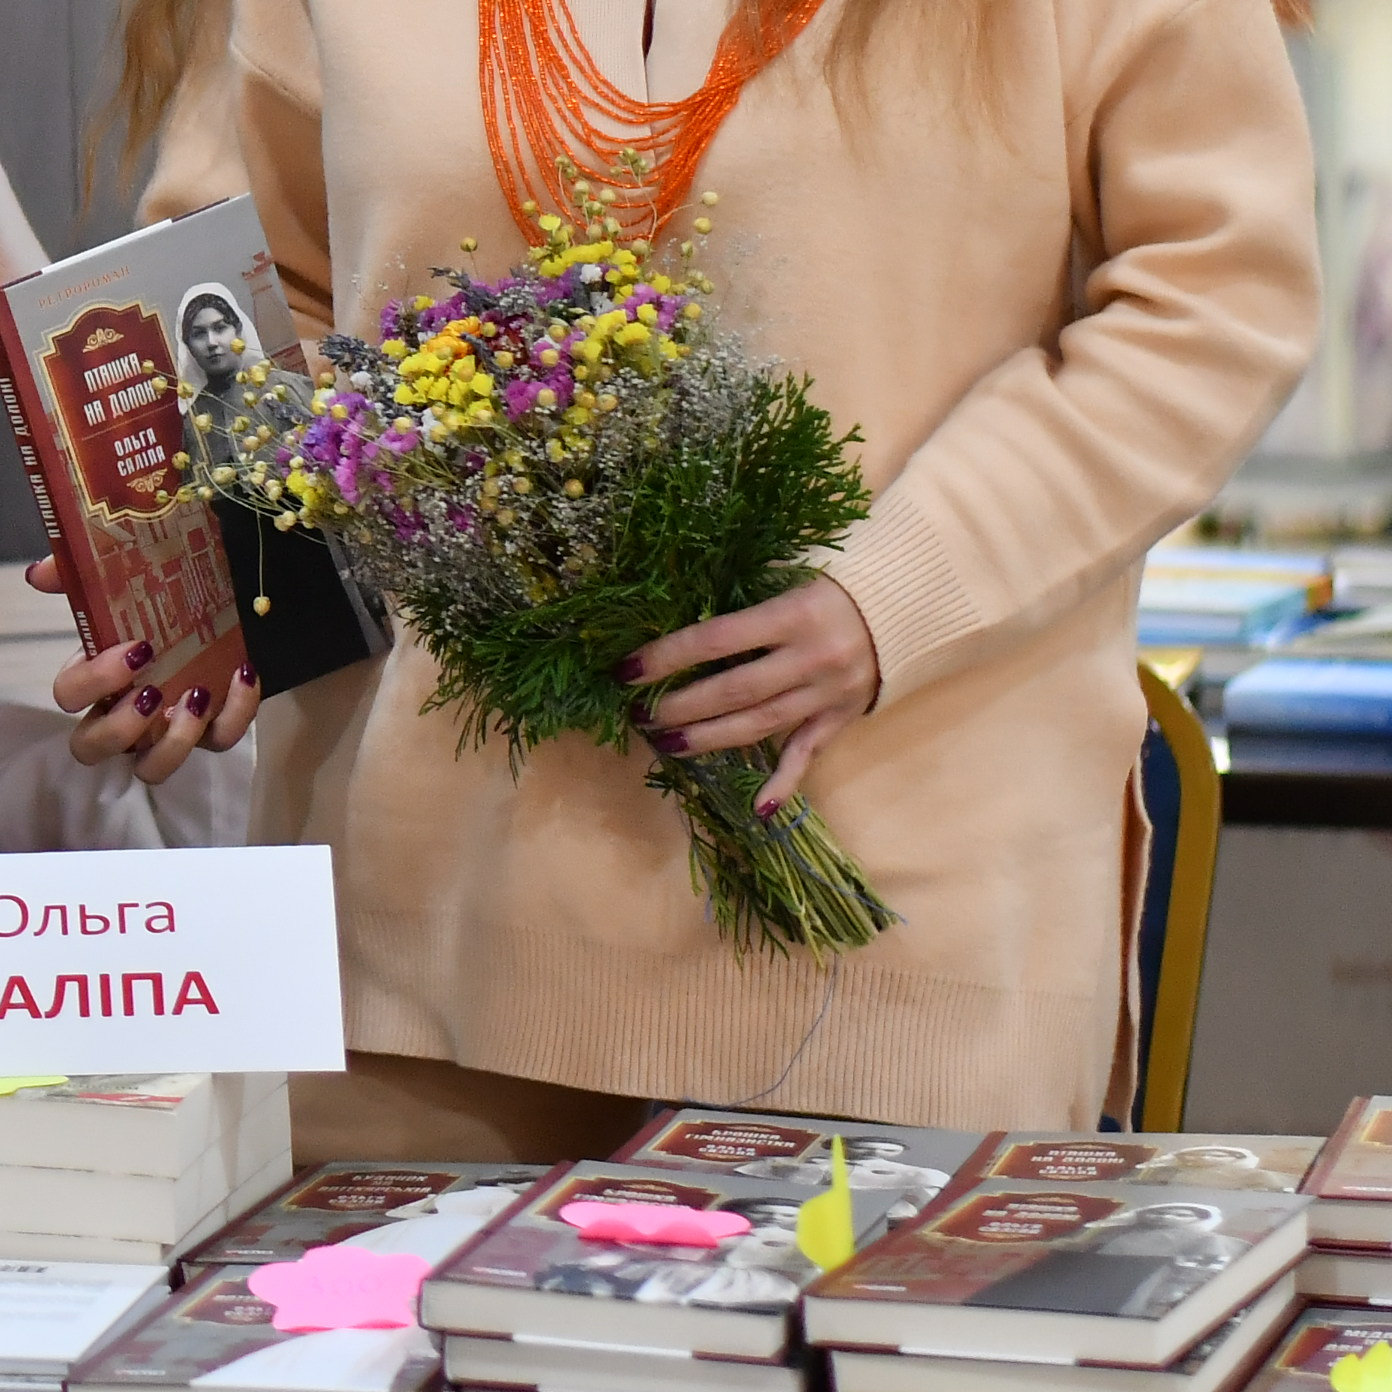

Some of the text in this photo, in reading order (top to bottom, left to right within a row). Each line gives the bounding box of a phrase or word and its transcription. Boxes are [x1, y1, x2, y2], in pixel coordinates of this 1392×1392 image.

[83, 351, 143, 394] ПТАШКА
[83, 378, 162, 427] НА ДОЛОН
[19, 444, 39, 467] НА
[113, 426, 158, 458] ОЛЬГА
[116, 444, 167, 478] САЛІПА
[29, 473, 62, 540] ПТАШКА
